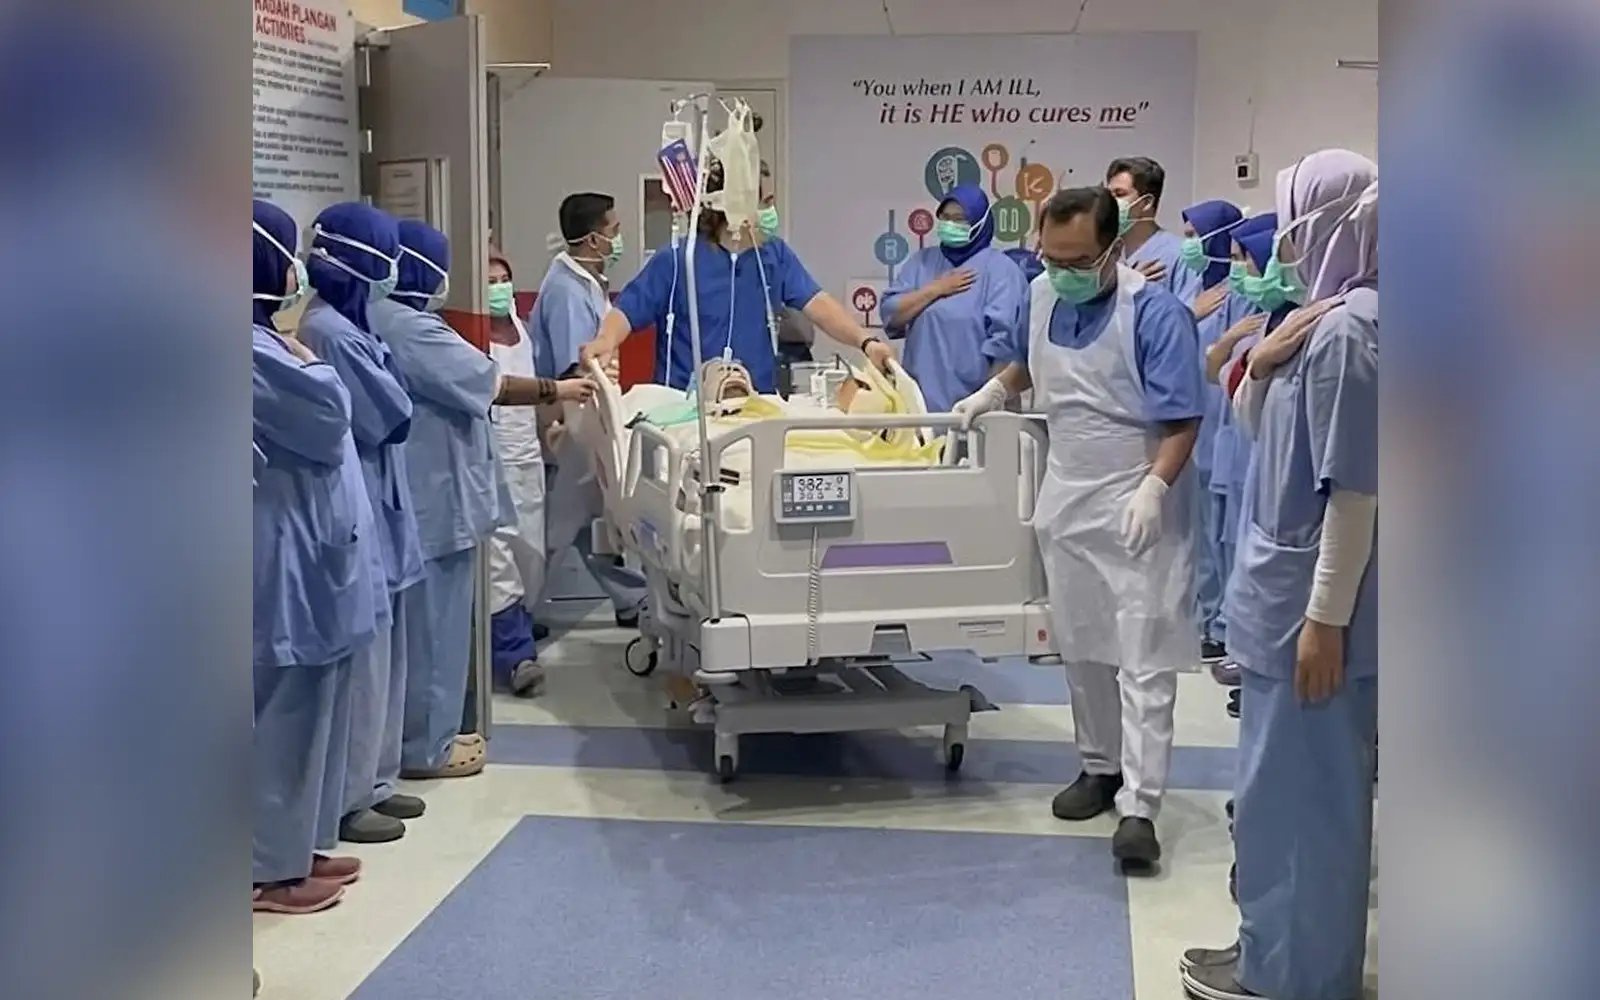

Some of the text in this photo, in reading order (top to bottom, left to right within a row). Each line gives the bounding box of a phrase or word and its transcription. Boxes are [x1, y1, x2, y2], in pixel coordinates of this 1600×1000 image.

[902, 78, 952, 96] when
[957, 79, 965, 96] I
[970, 79, 1003, 96] AM
[1008, 78, 1041, 97] ILL,
[880, 102, 896, 124] it
[903, 102, 923, 124] is
[929, 103, 965, 124] HE
[971, 101, 1021, 124] who
[1028, 106, 1092, 123] cures
